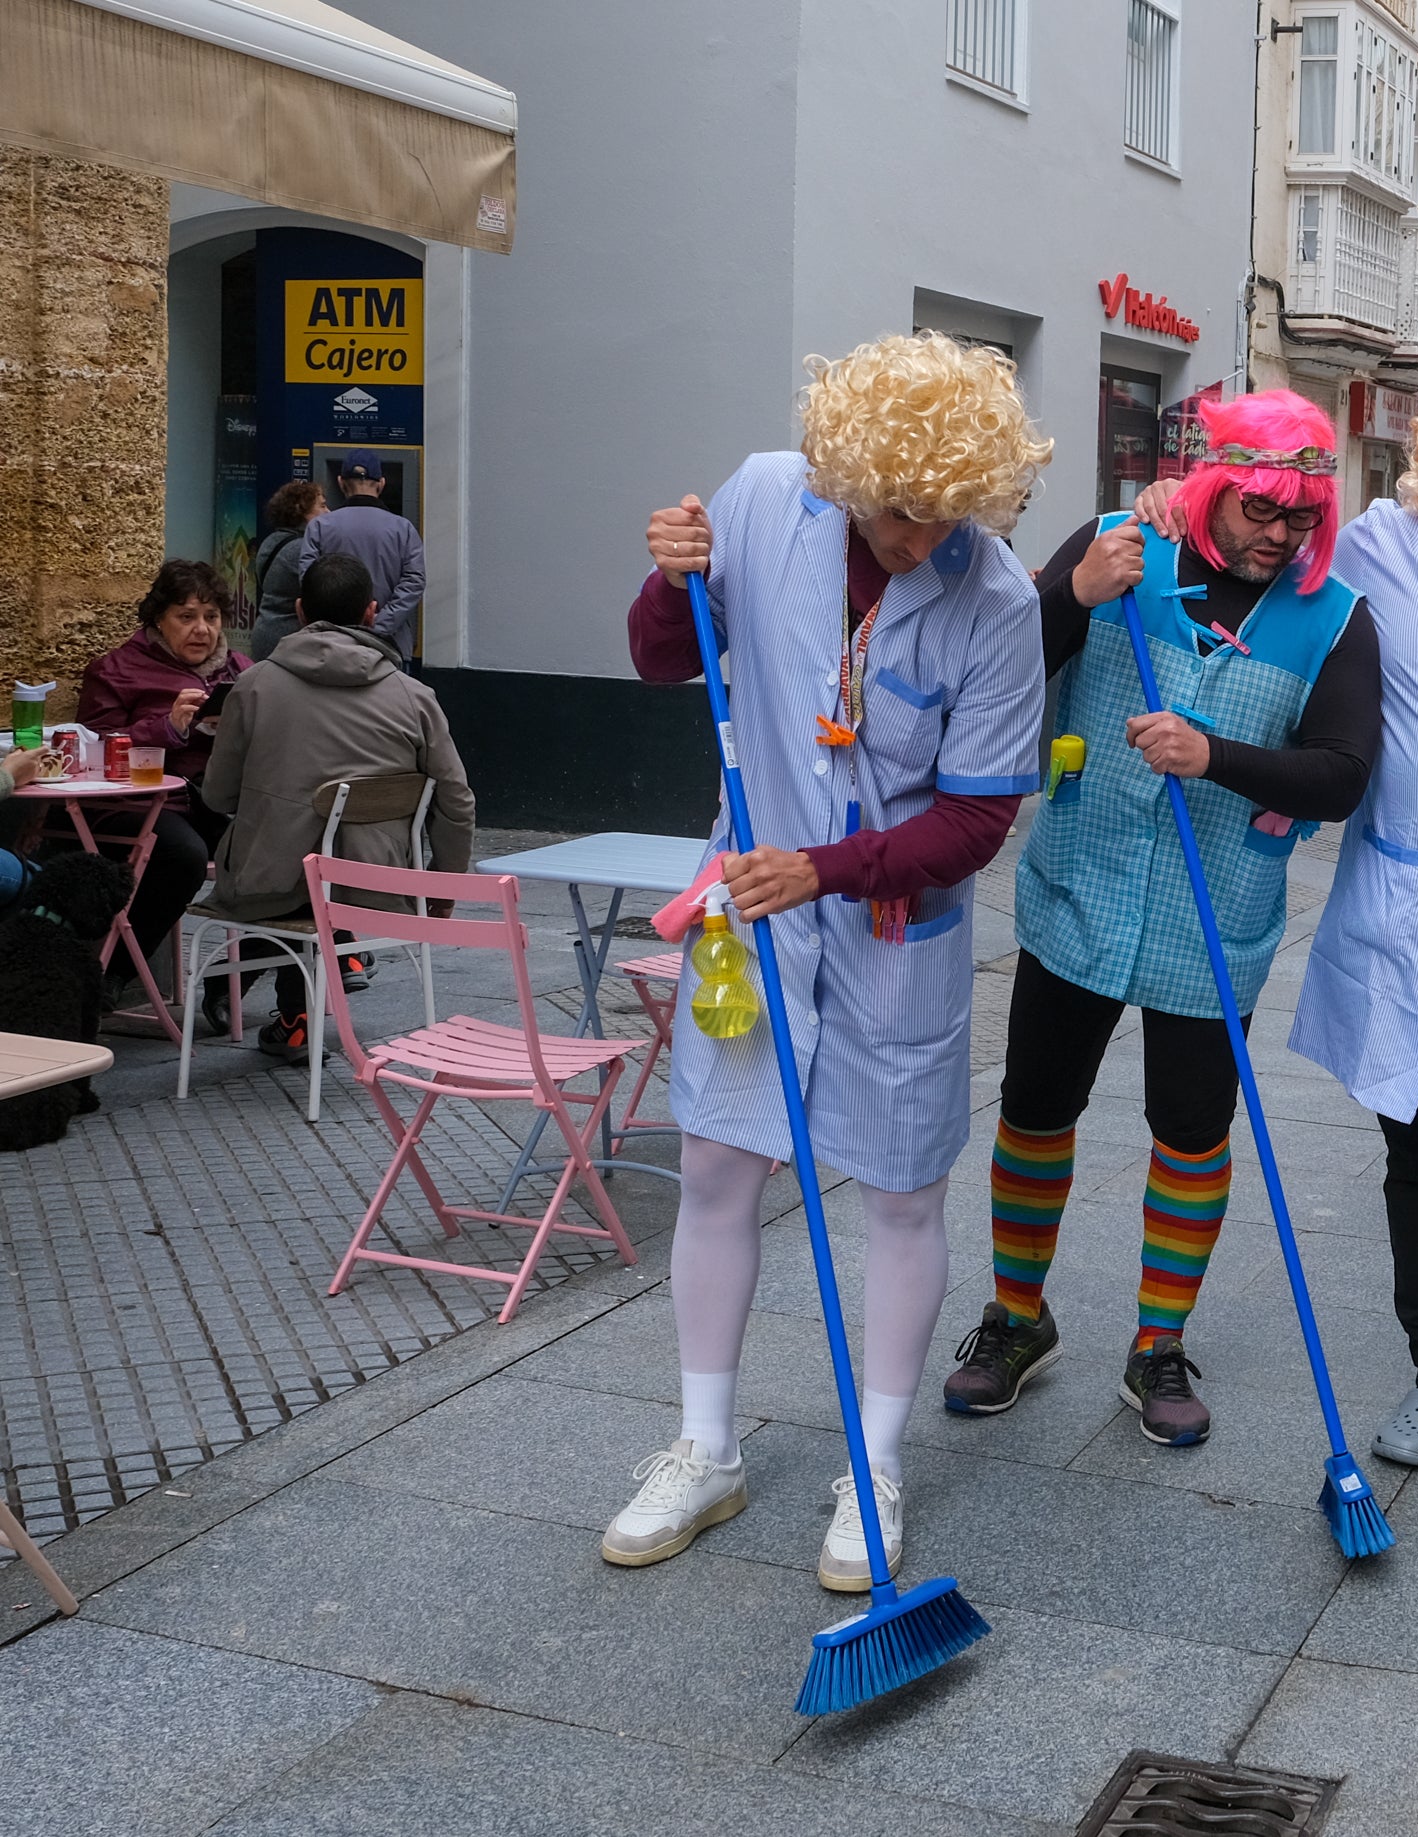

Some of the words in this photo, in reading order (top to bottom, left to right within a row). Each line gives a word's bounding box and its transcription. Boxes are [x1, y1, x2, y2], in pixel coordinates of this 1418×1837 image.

[308, 287, 405, 328] ATM
[305, 338, 408, 378] Cajero
[341, 395, 371, 405] Euronet
[1163, 440, 1179, 453] de
